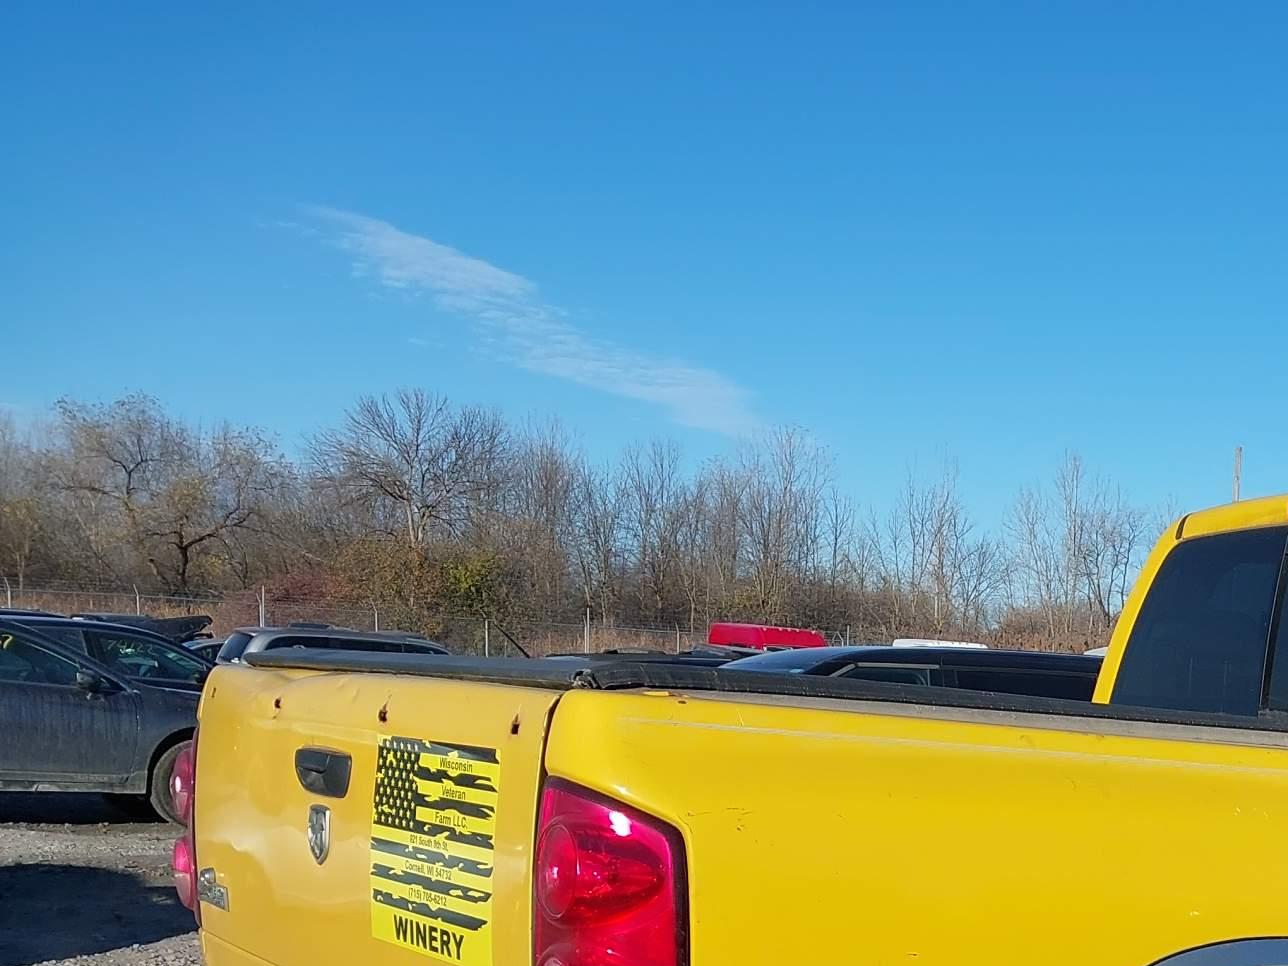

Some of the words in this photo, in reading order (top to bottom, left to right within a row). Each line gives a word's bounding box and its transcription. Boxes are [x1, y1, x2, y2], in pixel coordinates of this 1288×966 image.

[440, 756, 473, 773] Wisconsin
[441, 784, 466, 800] Veteran
[434, 811, 451, 826] Farm
[419, 836, 433, 849] South
[393, 914, 464, 960] WINERY
